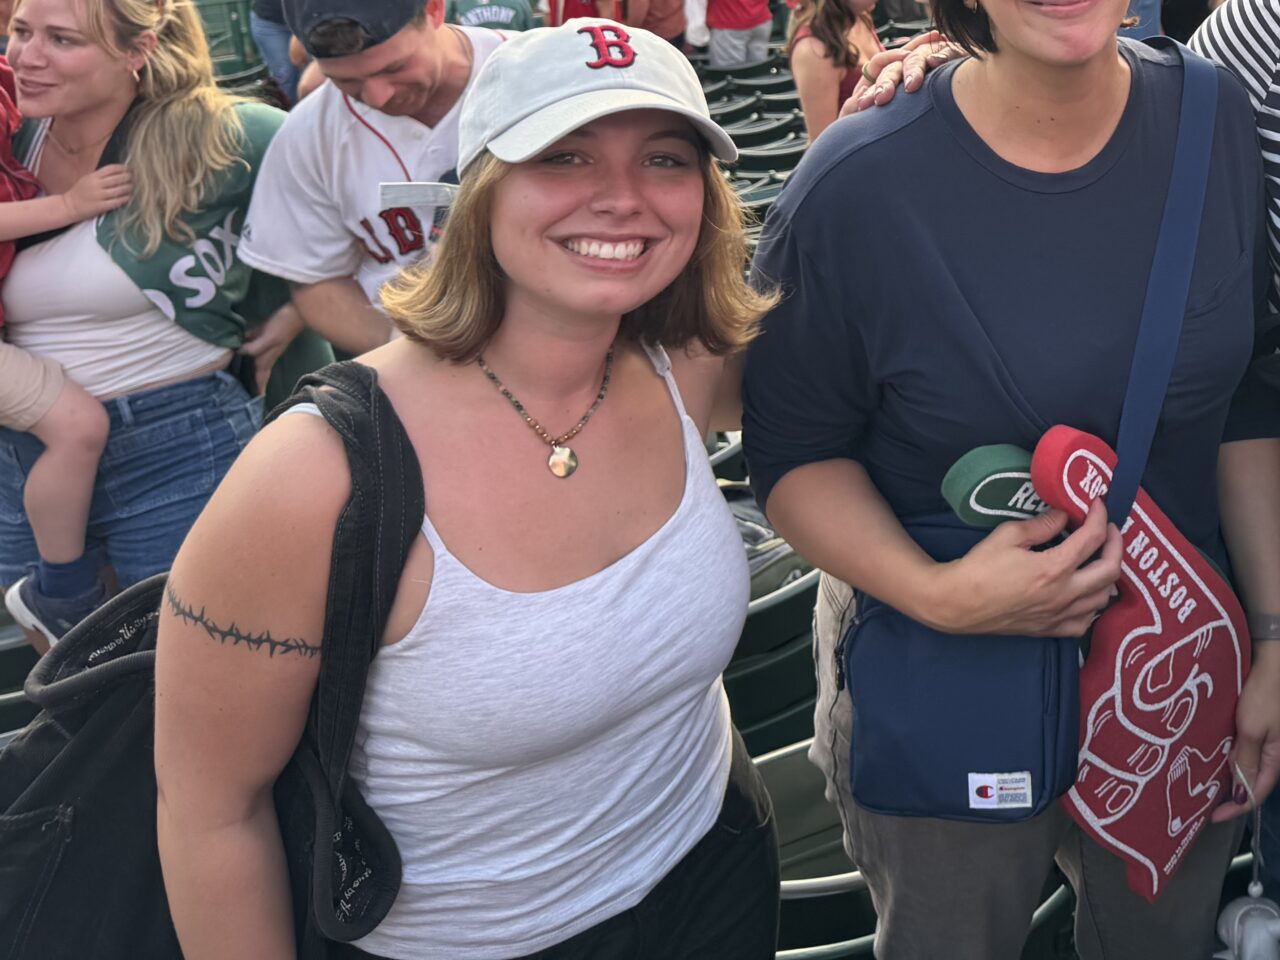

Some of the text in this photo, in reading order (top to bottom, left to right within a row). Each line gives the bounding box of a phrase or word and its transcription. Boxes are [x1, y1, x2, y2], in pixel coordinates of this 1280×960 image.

[577, 25, 637, 69] B
[169, 207, 240, 309] SOX
[1126, 530, 1197, 623] BOSTON
